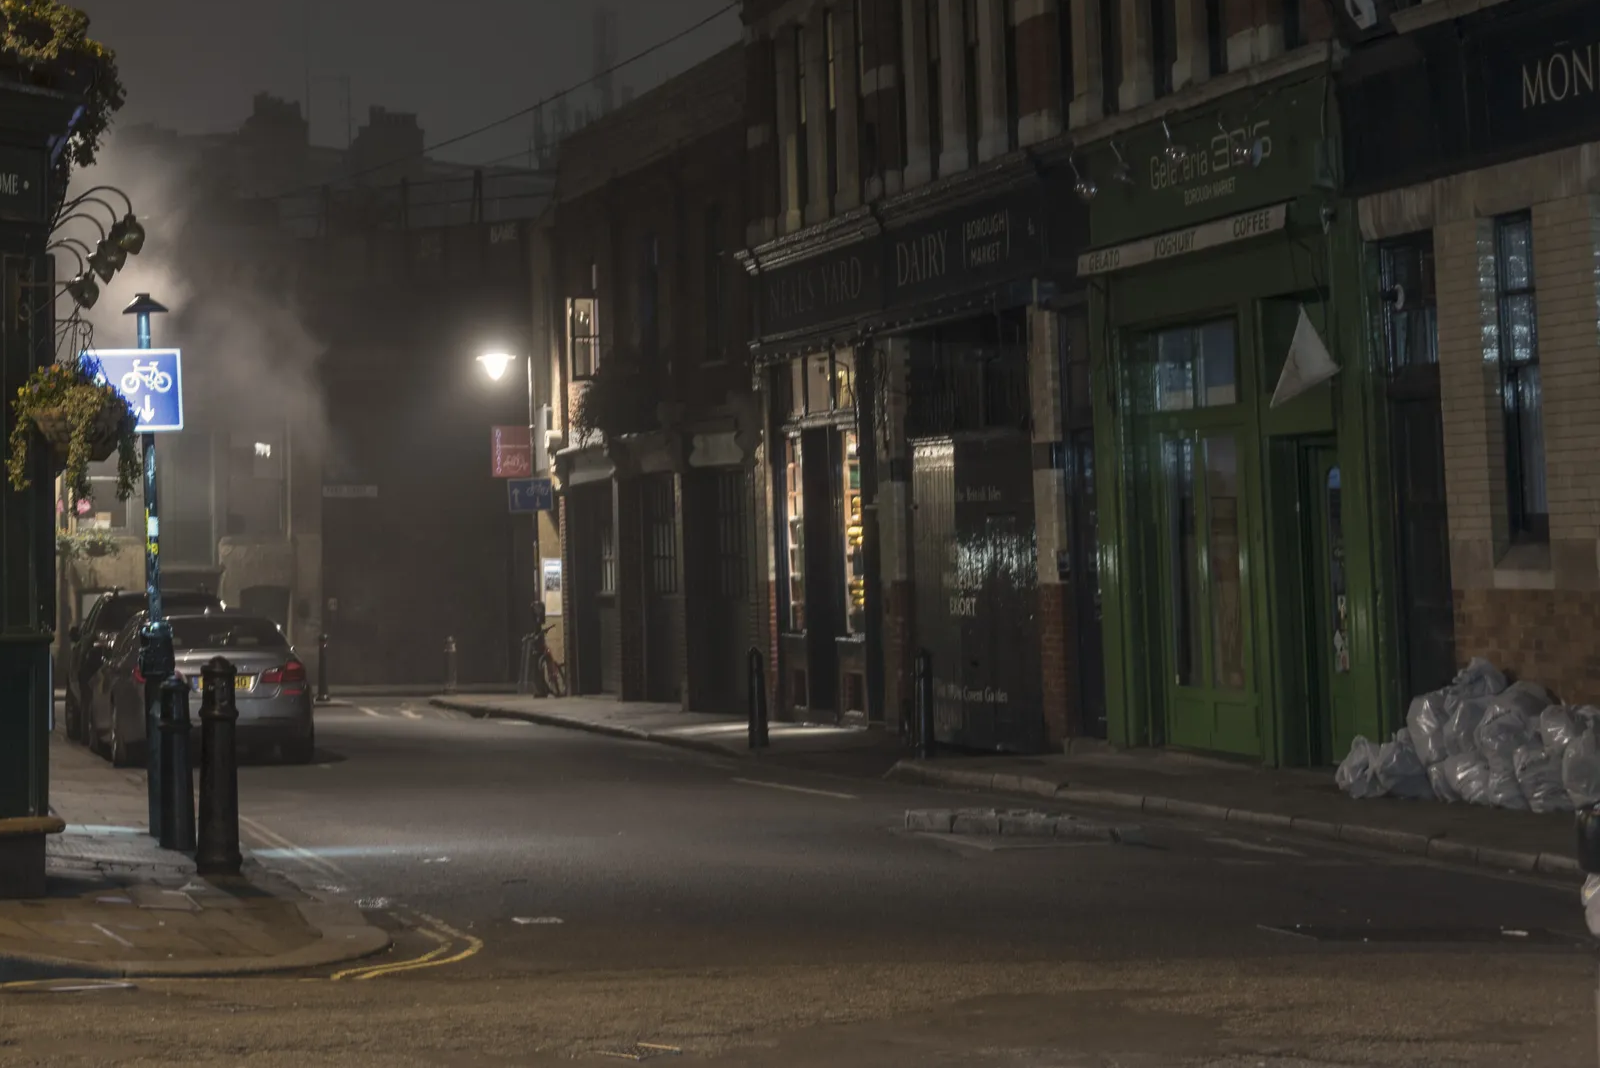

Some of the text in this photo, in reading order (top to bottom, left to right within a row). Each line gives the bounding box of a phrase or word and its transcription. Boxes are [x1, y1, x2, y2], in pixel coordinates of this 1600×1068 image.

[1522, 42, 1600, 110] MON
[1150, 144, 1208, 190] Gelaeria
[1184, 176, 1236, 206] BOROUGH MARKET
[966, 213, 1005, 242] BOROUGH
[1233, 211, 1271, 238] COFFEE
[970, 241, 1001, 263] MARKET
[1089, 249, 1120, 272] GELATO
[821, 257, 862, 305] YARD
[896, 229, 948, 288] DAIRY
